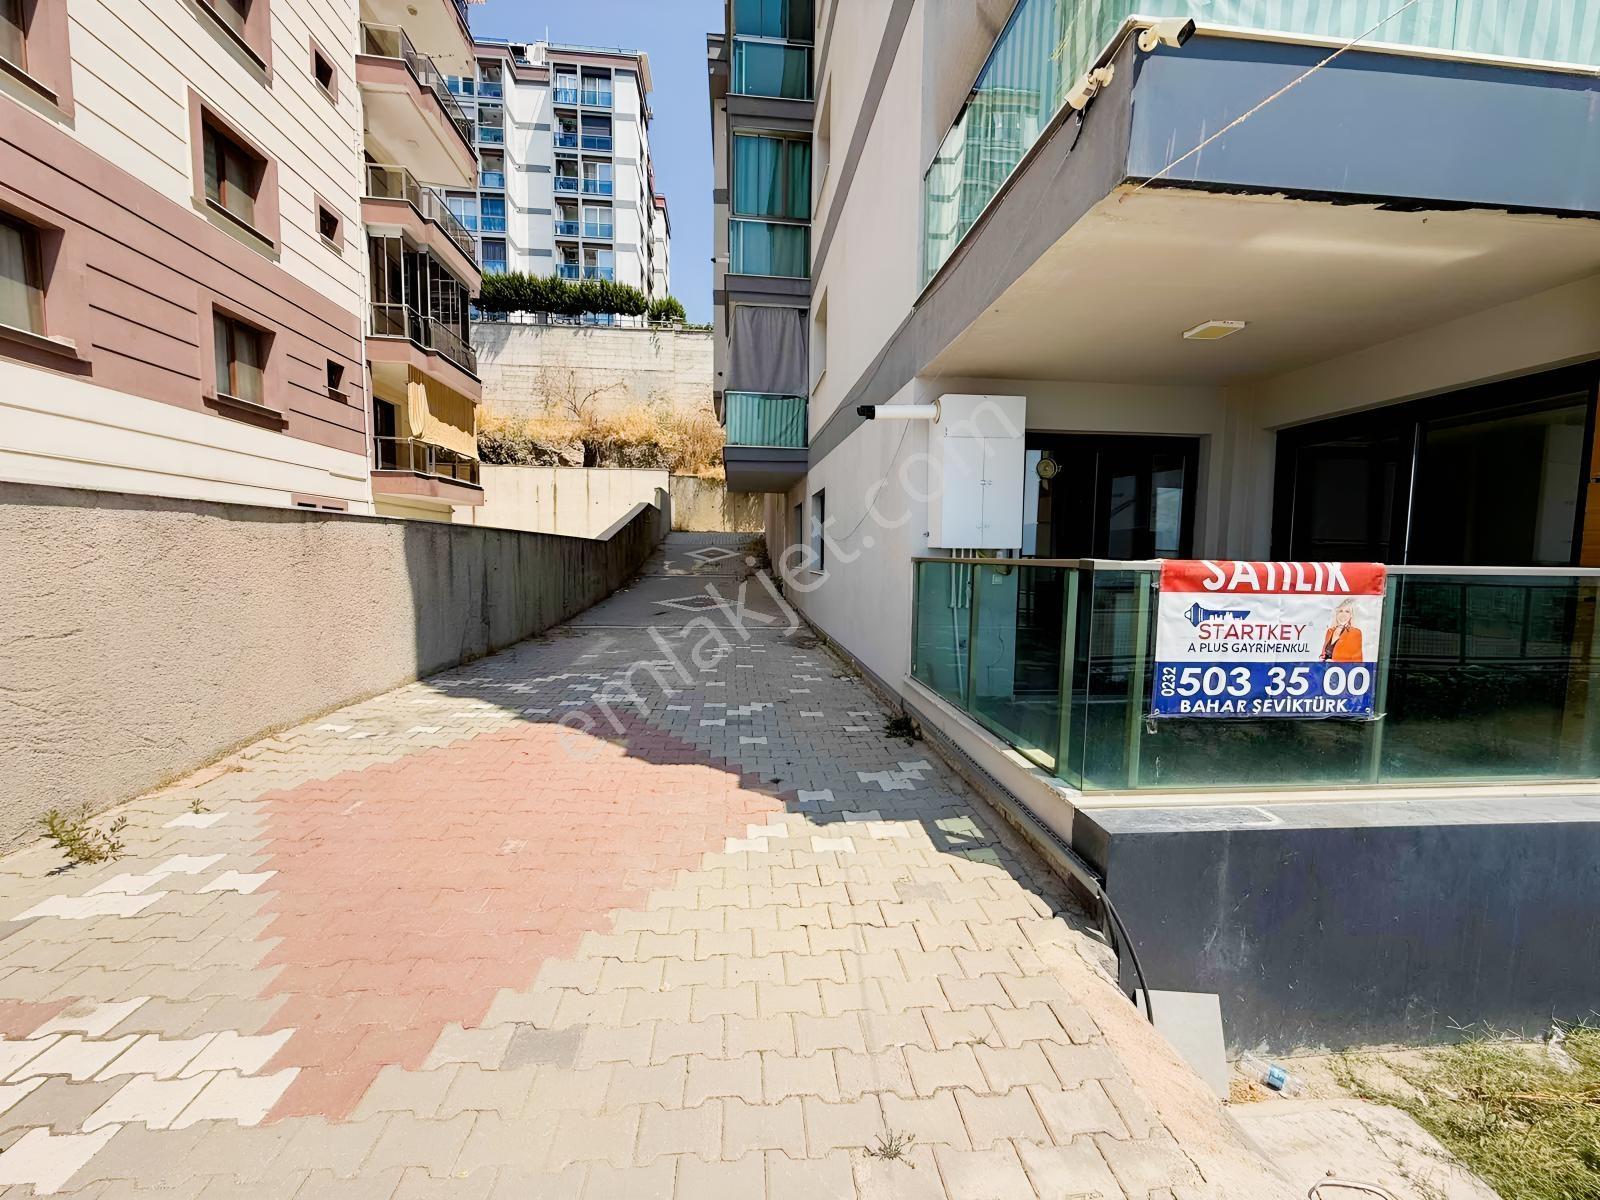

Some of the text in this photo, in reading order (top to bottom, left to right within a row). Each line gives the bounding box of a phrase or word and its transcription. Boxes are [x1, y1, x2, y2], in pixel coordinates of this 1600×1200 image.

[1198, 623, 1307, 640] STARTKEY
[1187, 640, 1310, 653] A PLUS GAYRİMENKUL
[1161, 666, 1176, 697] 0232
[1176, 666, 1371, 696] 503 35 00
[1180, 697, 1349, 714] BAHAR ŞEVİKTÜRK
